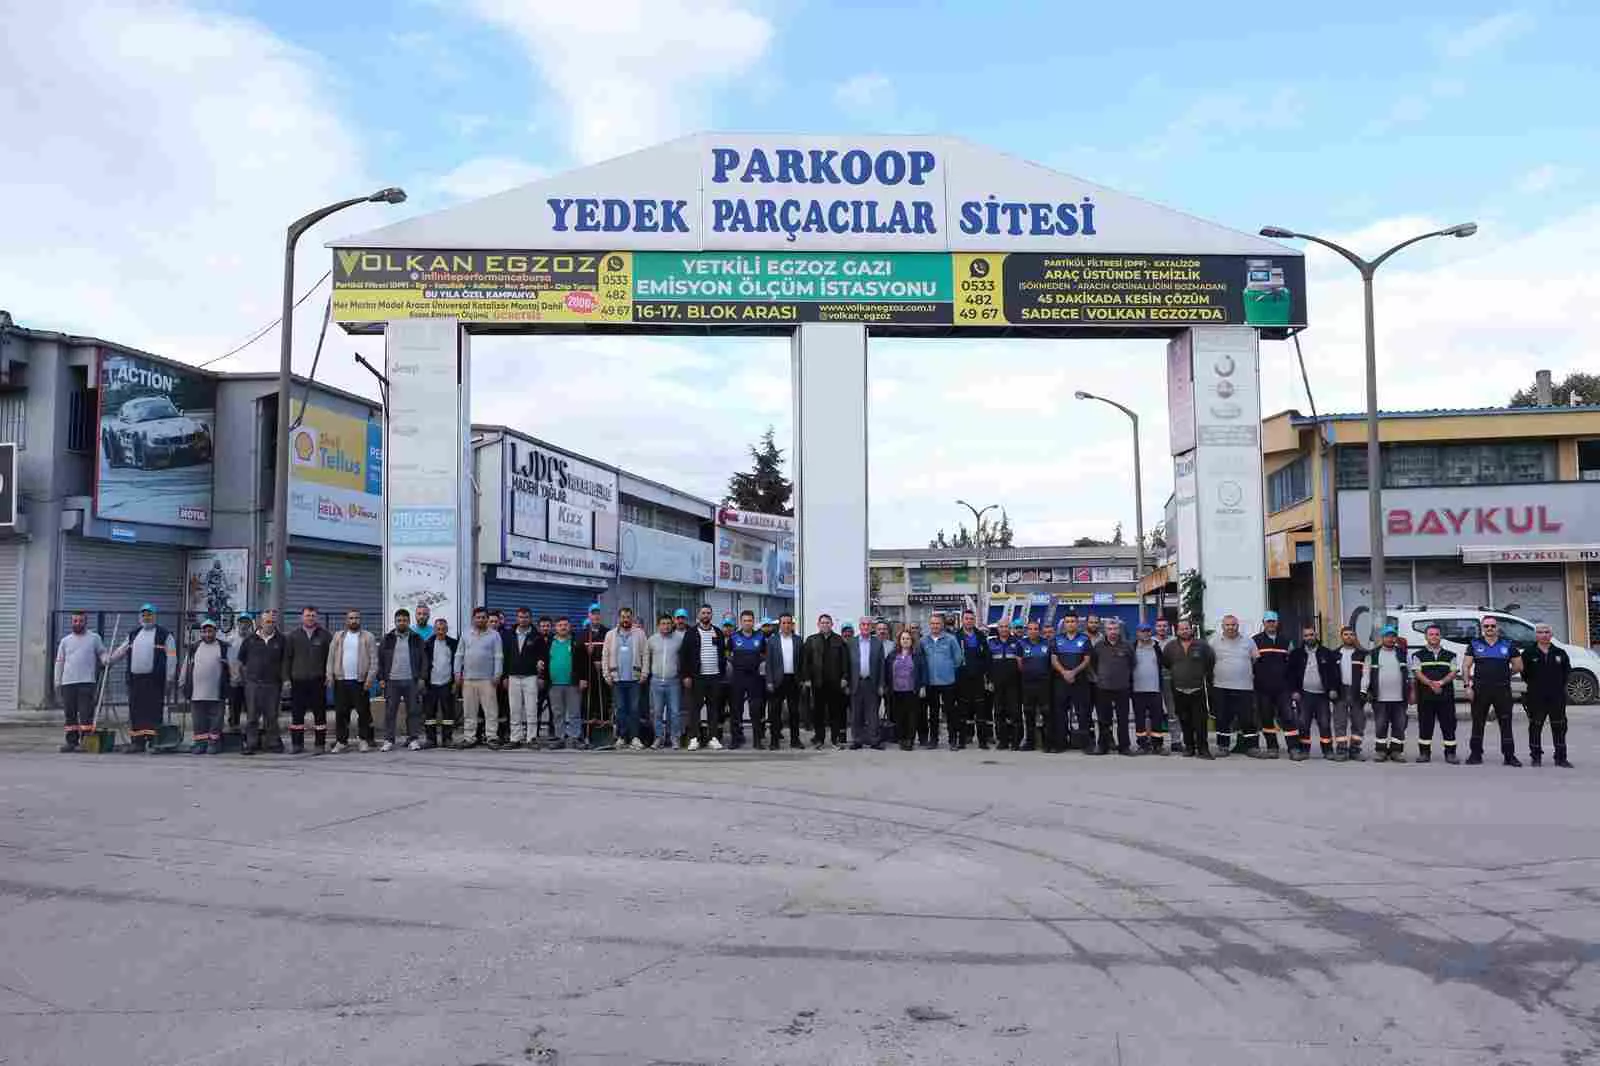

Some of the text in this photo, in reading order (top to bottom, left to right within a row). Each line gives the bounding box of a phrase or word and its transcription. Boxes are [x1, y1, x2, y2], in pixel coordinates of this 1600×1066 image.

[711, 148, 936, 186] PARKOOP
[547, 194, 1096, 241] YEDEK PARÇACILAR SİTESİ
[337, 250, 597, 277] VOLKAN EGZOZ
[682, 256, 892, 276] YETKİLİ EGZOZ GAZI
[602, 274, 628, 285] 0533
[1043, 268, 1201, 281] ARAÇ ÜSTÜNDE TEMİZLİK
[636, 275, 937, 301] EMİSYON ÖLÇÜM İSTASYONU
[961, 280, 995, 292] 0533
[425, 288, 537, 299] BU YILA ÖZEL KAMPANYA
[606, 290, 626, 300] 482
[965, 294, 992, 305] 482
[1037, 292, 1210, 306] 45 DAKİKADA KESİN ÇÖZÜM
[600, 305, 631, 316] 49 67
[635, 304, 797, 320] 16-17. BLOK ARASI
[959, 308, 999, 320] 49 67
[1021, 308, 1223, 320] SADECE VOLKAN EGZOZ'DA
[1387, 505, 1564, 536] BAYKUL
[1502, 551, 1569, 561] BAYKUL
